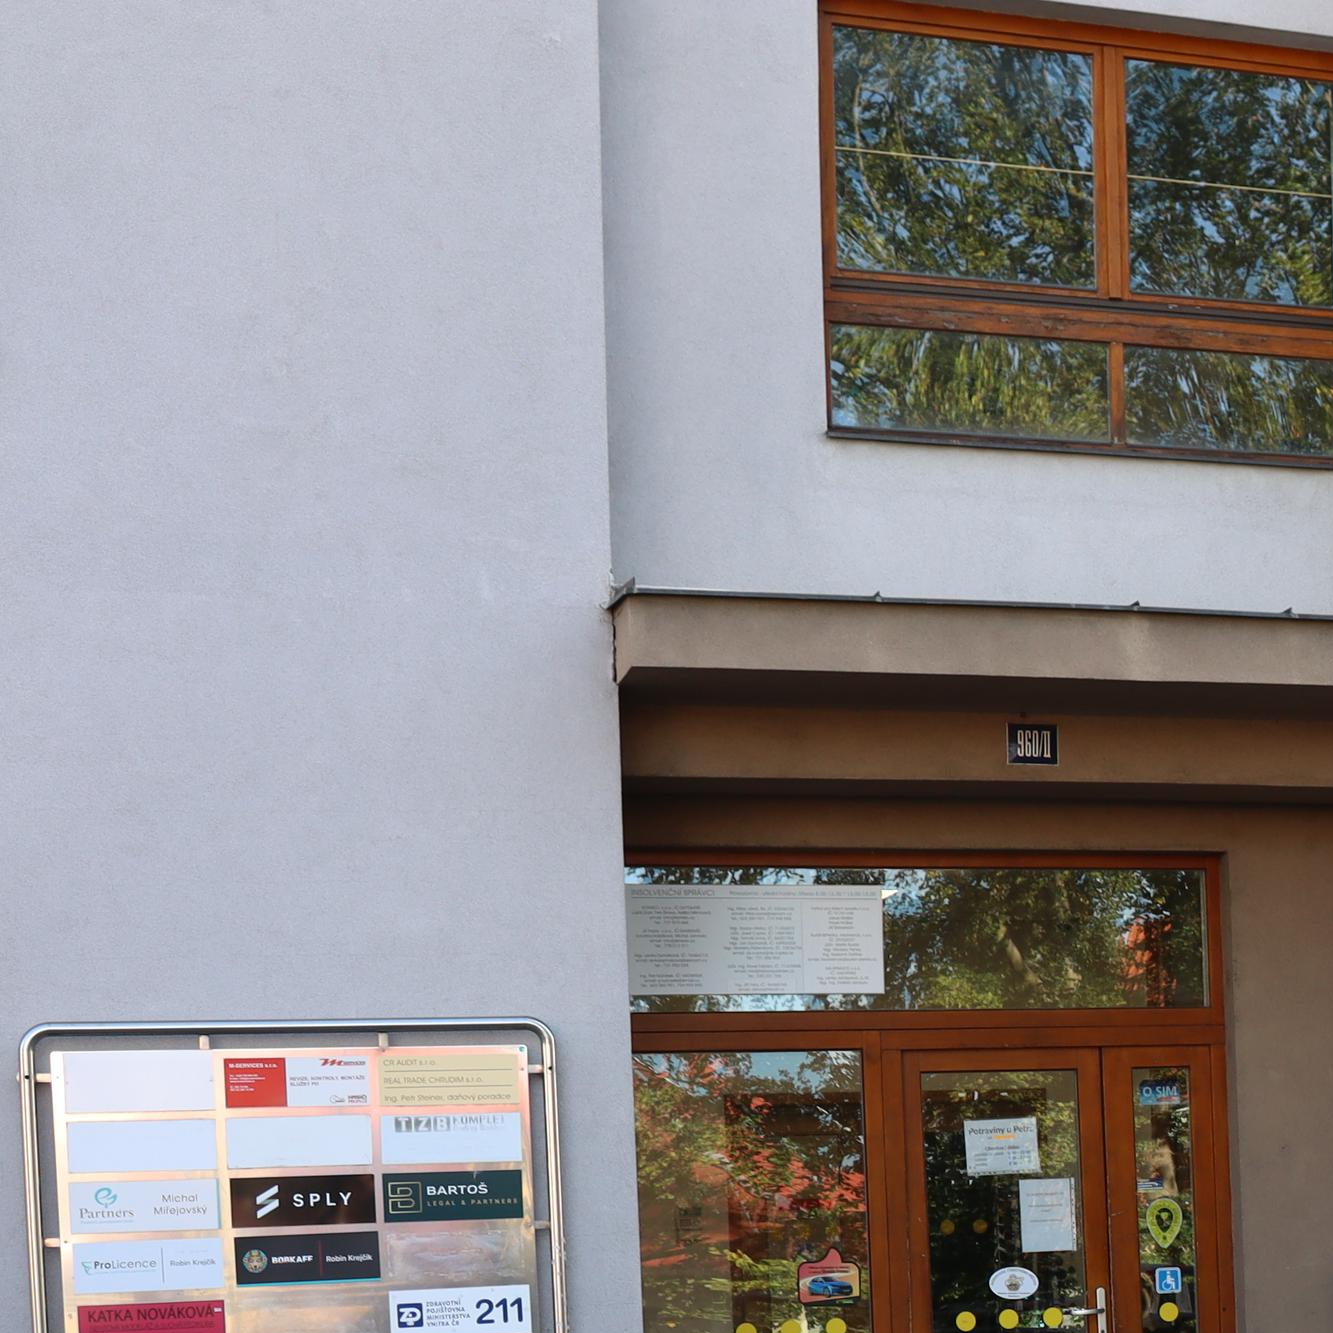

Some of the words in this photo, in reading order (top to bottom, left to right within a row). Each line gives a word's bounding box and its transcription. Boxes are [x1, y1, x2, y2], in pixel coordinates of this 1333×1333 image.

[403, 1076, 427, 1084] TRADE
[1155, 1086, 1178, 1096] SIM
[477, 1093, 511, 1102] poradce
[426, 1182, 489, 1196] BARTOŠ
[161, 1194, 198, 1203] Michal
[293, 1192, 352, 1208] SPLY
[470, 1198, 518, 1206] PARTNERS
[79, 1208, 135, 1219] Partners
[153, 1205, 208, 1216] Miřejovský
[325, 1254, 347, 1263] Robin
[93, 1259, 157, 1270] ProLicence
[88, 1310, 133, 1323] KATKA
[137, 1304, 214, 1321] NOVÁKOVÁ
[475, 1297, 523, 1324] 211
